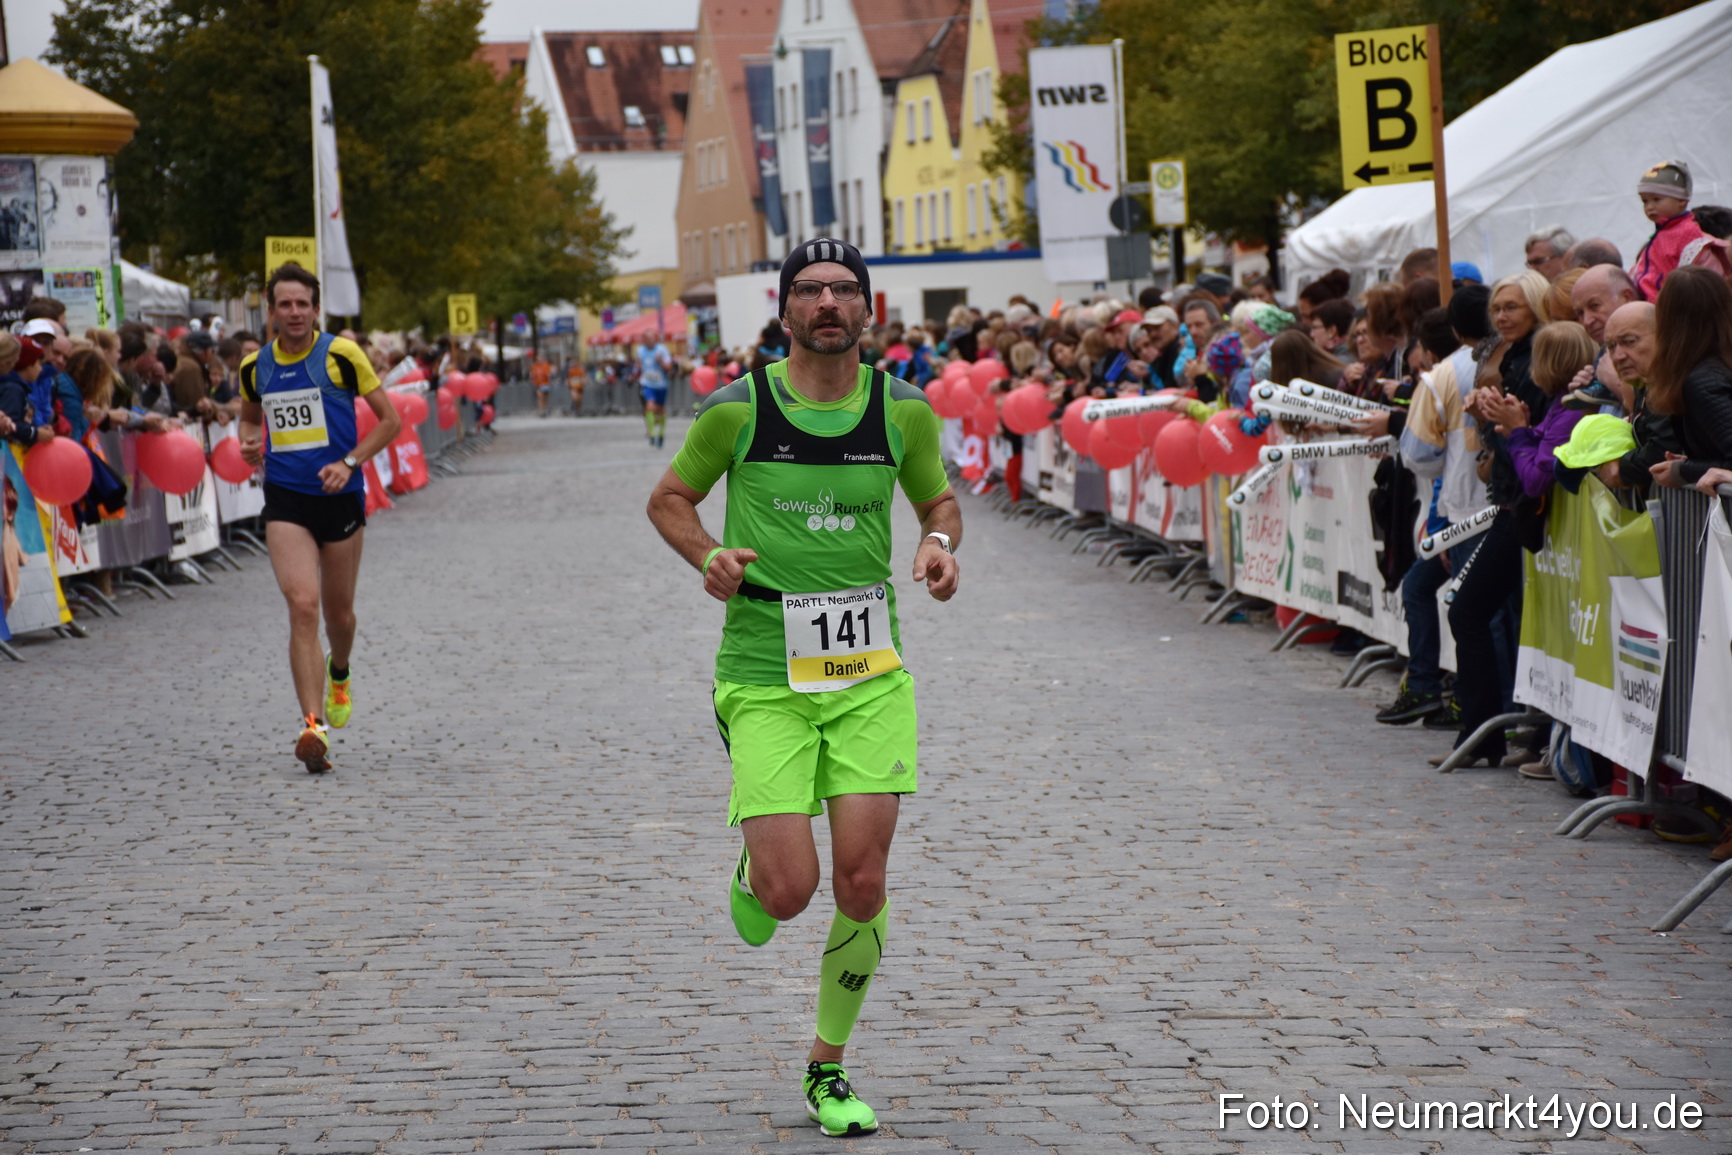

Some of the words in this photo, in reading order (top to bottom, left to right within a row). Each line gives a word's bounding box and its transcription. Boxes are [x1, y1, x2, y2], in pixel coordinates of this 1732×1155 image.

[1348, 33, 1428, 67] Block
[1365, 77, 1418, 152] B
[271, 240, 309, 255] Block
[456, 307, 469, 326] D
[273, 405, 312, 429] 539
[1281, 394, 1364, 421] bmw-laufsport
[844, 453, 886, 461] FrankenBlitz
[1292, 447, 1325, 460] BMW
[1329, 442, 1390, 457] Laufsport
[773, 498, 824, 514] SoWiso
[1441, 518, 1472, 542] BMW
[786, 597, 825, 609] PARTL
[828, 591, 874, 606] Neumarkt
[811, 607, 870, 650] 141
[824, 658, 870, 676] Daniel
